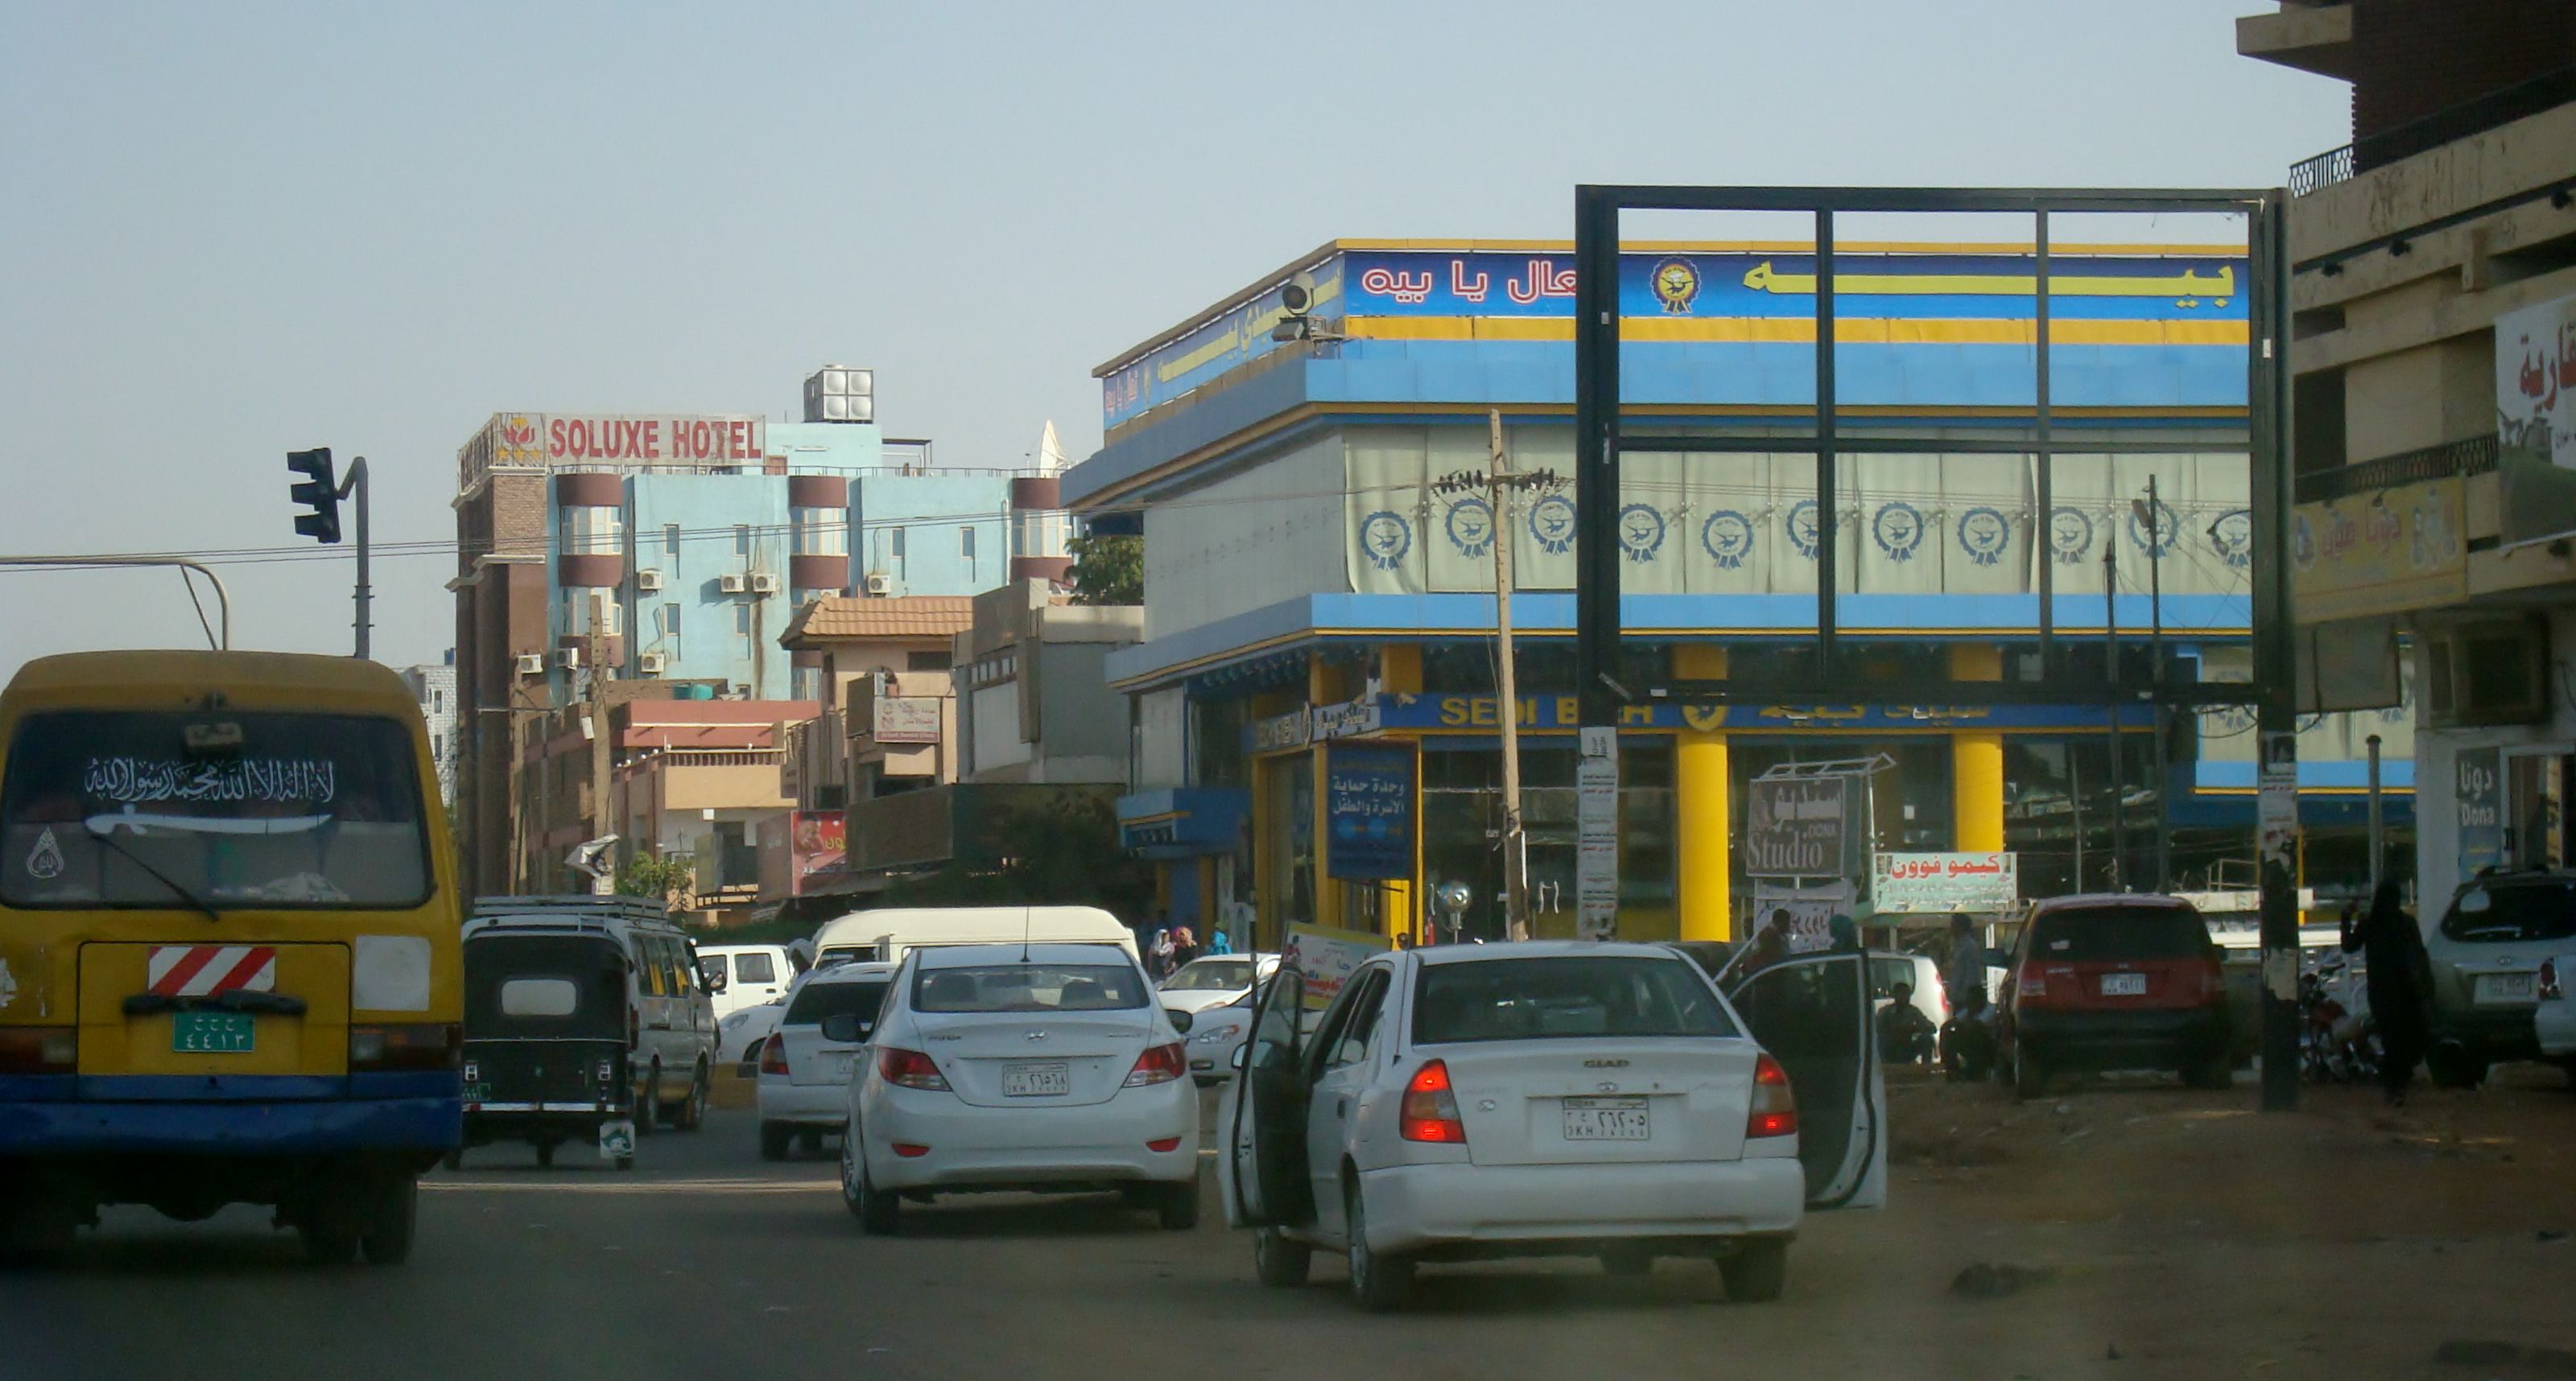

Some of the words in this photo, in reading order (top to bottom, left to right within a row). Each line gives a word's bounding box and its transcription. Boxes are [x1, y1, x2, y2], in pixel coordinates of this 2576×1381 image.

[1361, 268, 1433, 303] بيه
[1451, 260, 1488, 303] يا
[1508, 260, 1576, 304] عال
[549, 418, 659, 459] SOLUXE
[672, 420, 762, 460] HOTEL
[1372, 777, 1405, 797] وحدة
[2462, 802, 2495, 827] Dona
[1748, 831, 1823, 870] Studio
[1891, 854, 1942, 880] فوون
[1946, 854, 2001, 879] كيمو
